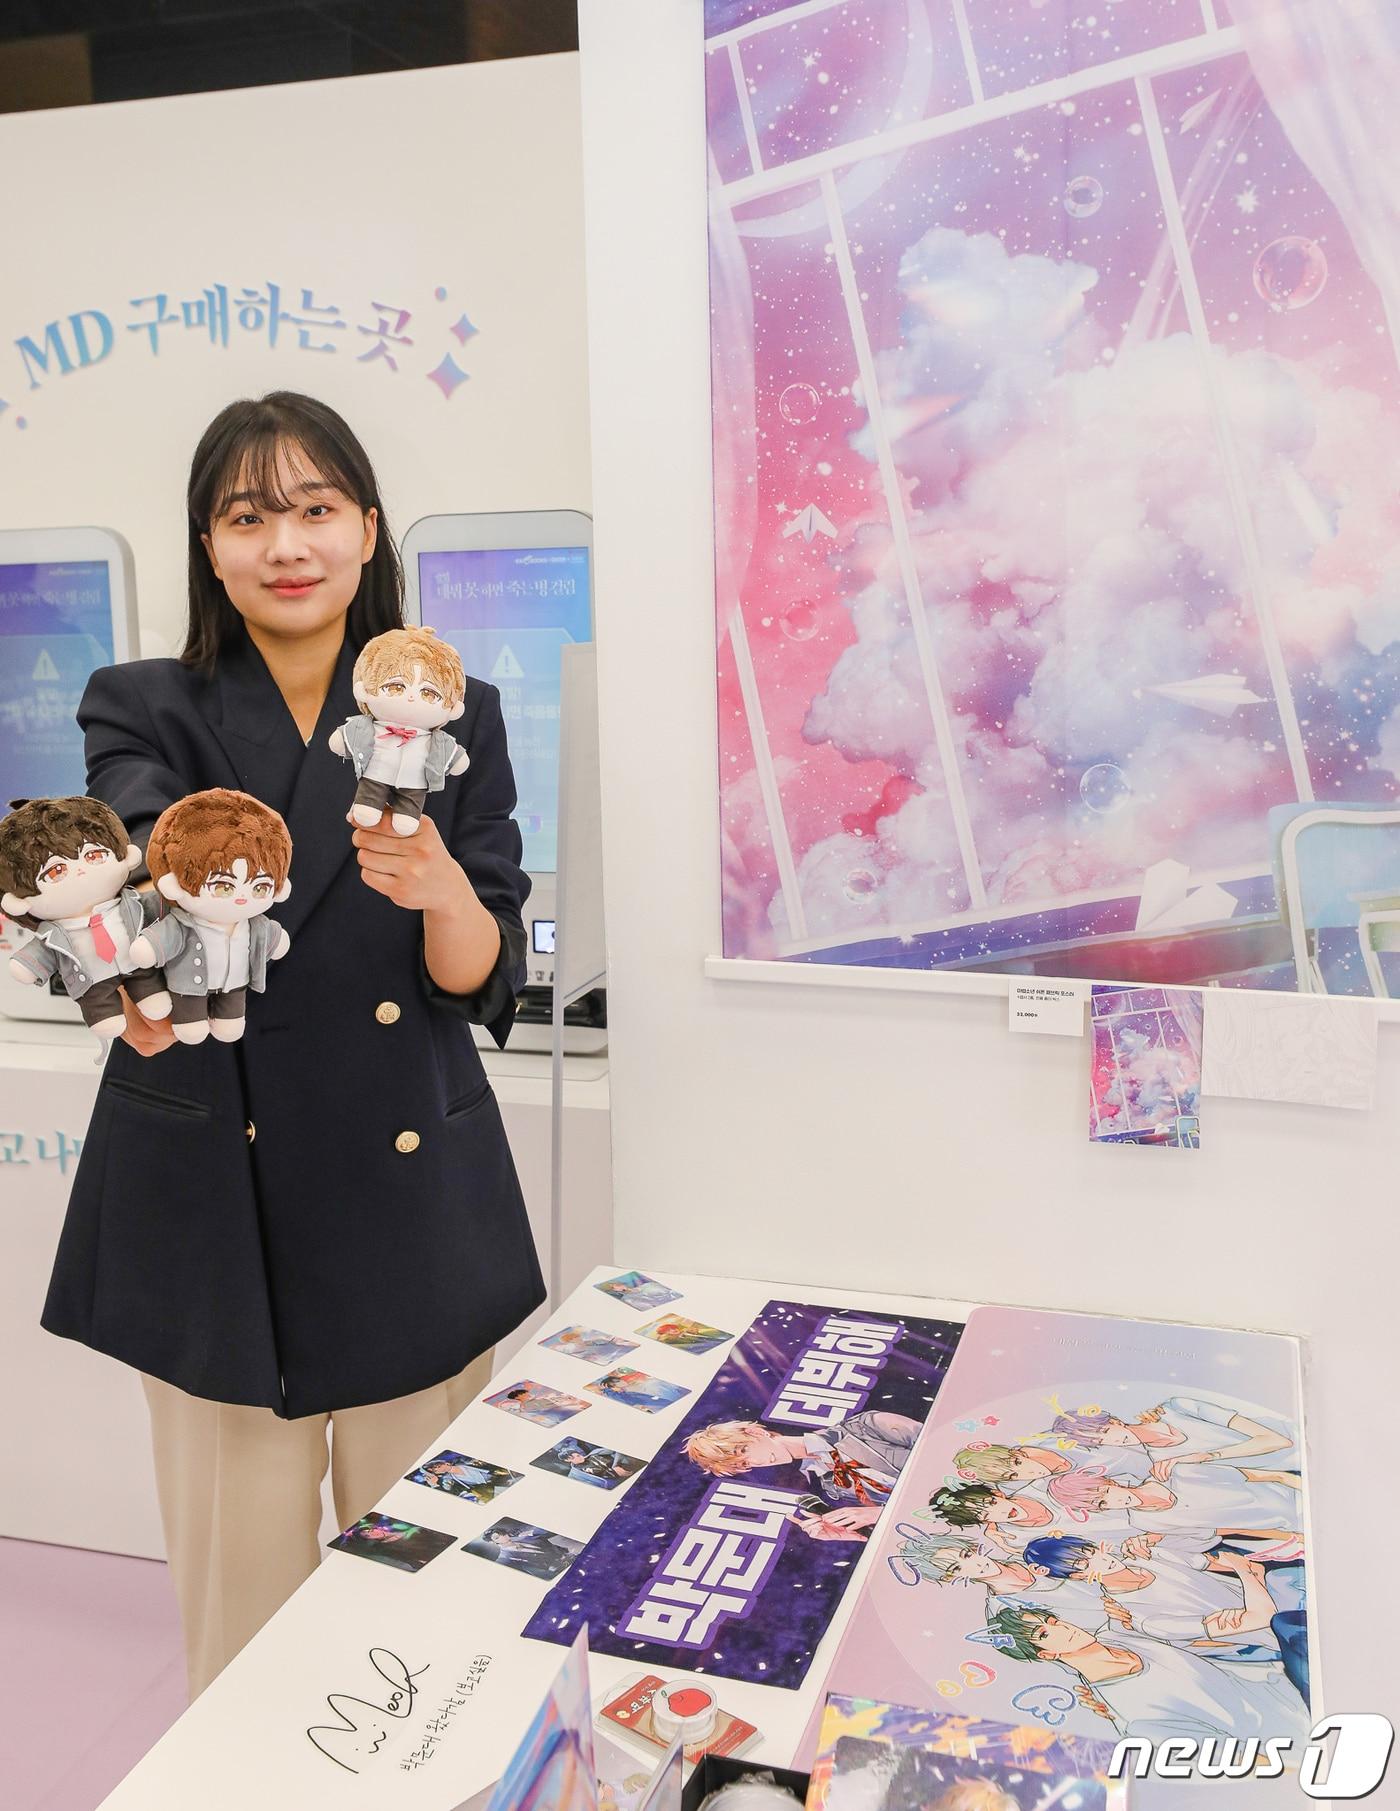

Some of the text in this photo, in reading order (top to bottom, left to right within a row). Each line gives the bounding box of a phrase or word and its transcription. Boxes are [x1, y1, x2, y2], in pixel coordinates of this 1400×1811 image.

[15, 281, 415, 391] MD 구매하는 곳
[768, 1319, 900, 1426] 데뷔해
[628, 1482, 803, 1645] 박문대
[400, 1734, 442, 1772] 박문대
[426, 1697, 467, 1733] 왔다감
